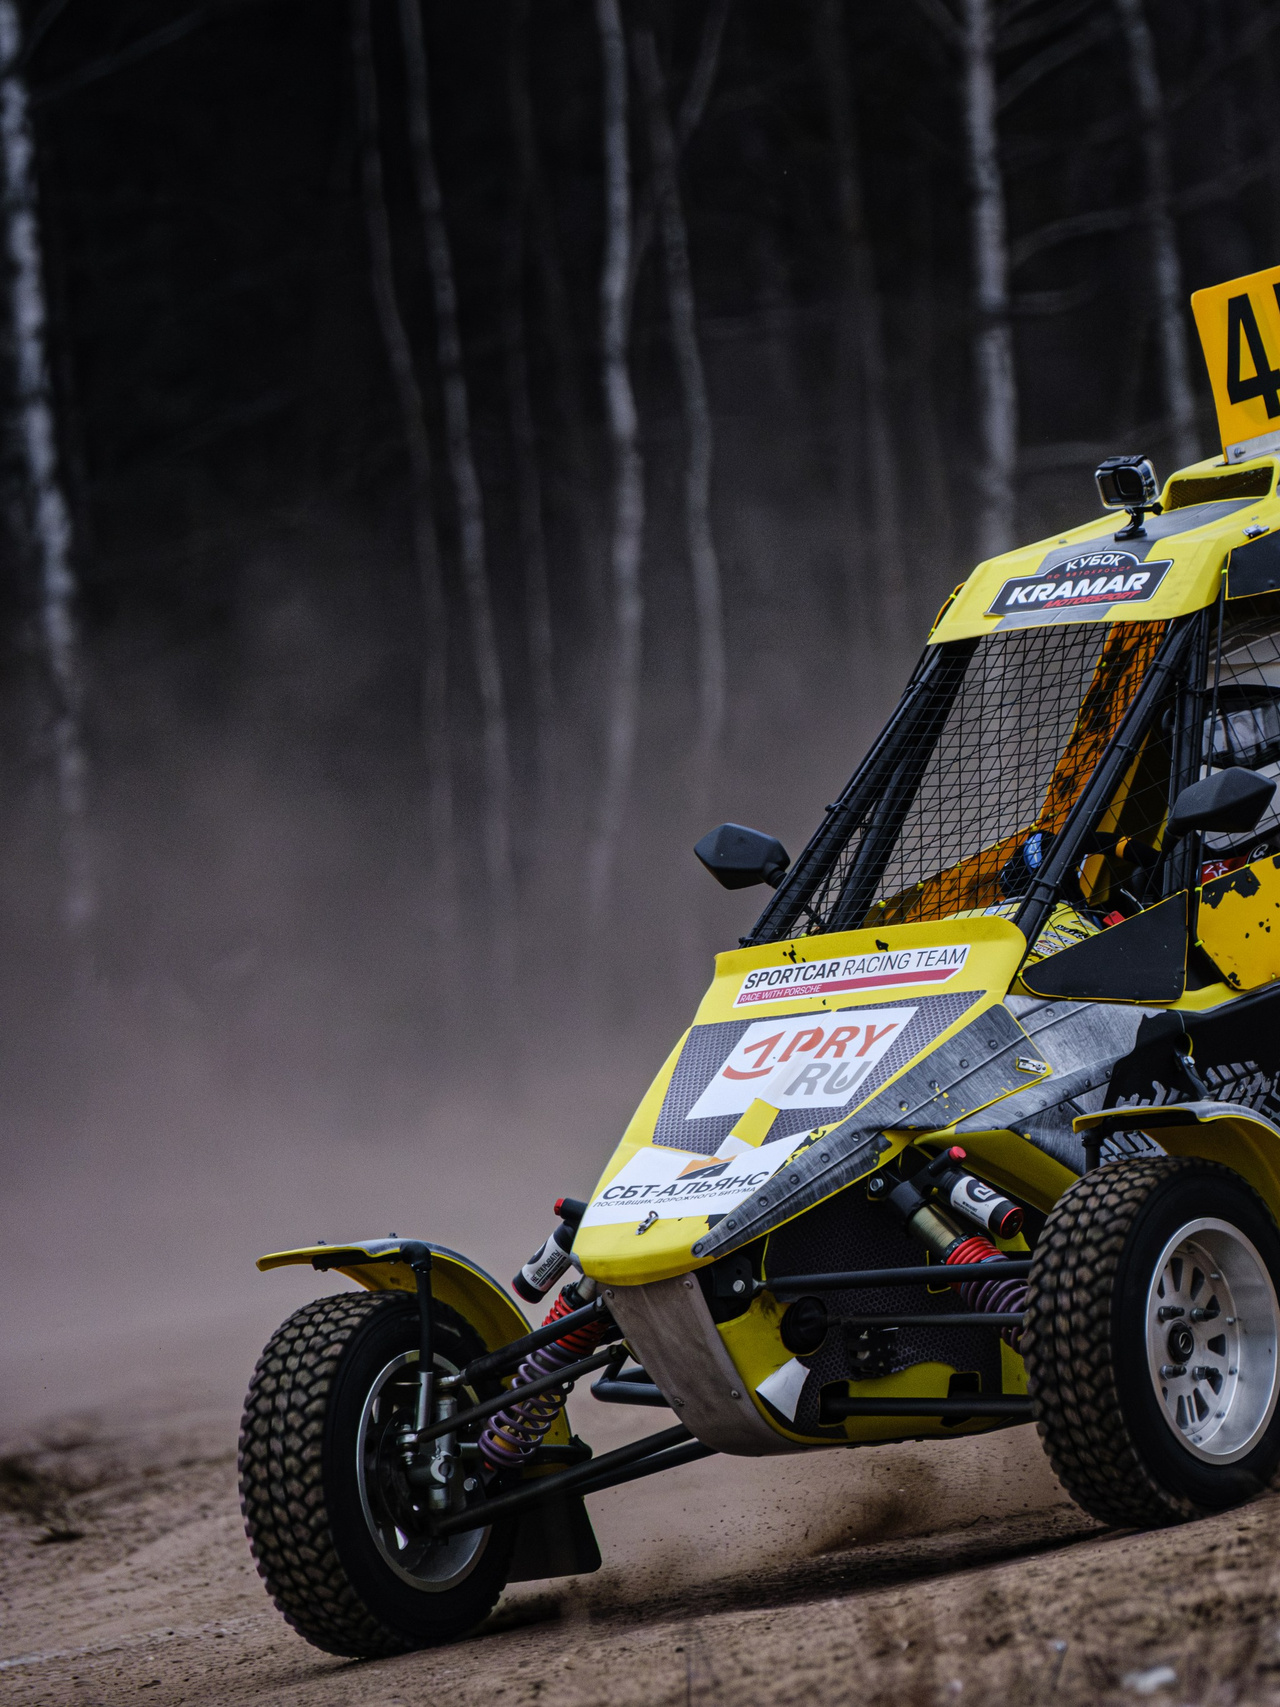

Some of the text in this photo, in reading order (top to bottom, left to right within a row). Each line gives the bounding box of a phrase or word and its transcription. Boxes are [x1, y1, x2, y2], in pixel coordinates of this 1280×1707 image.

[1066, 554, 1126, 572] КУБОК
[1005, 572, 1151, 606] KRAMAR
[1042, 590, 1142, 609] MOTORSPORT
[744, 948, 968, 990] SPORTCAR RACING TEAM
[739, 984, 823, 1003] RACE WITH PORSCHE
[783, 1061, 873, 1097] RU
[592, 1186, 756, 1208] ПОСТАВЩИК ДОРОЖНОГО БИТУМА
[602, 1171, 770, 1200] СБТ-АЛЬЯНС
